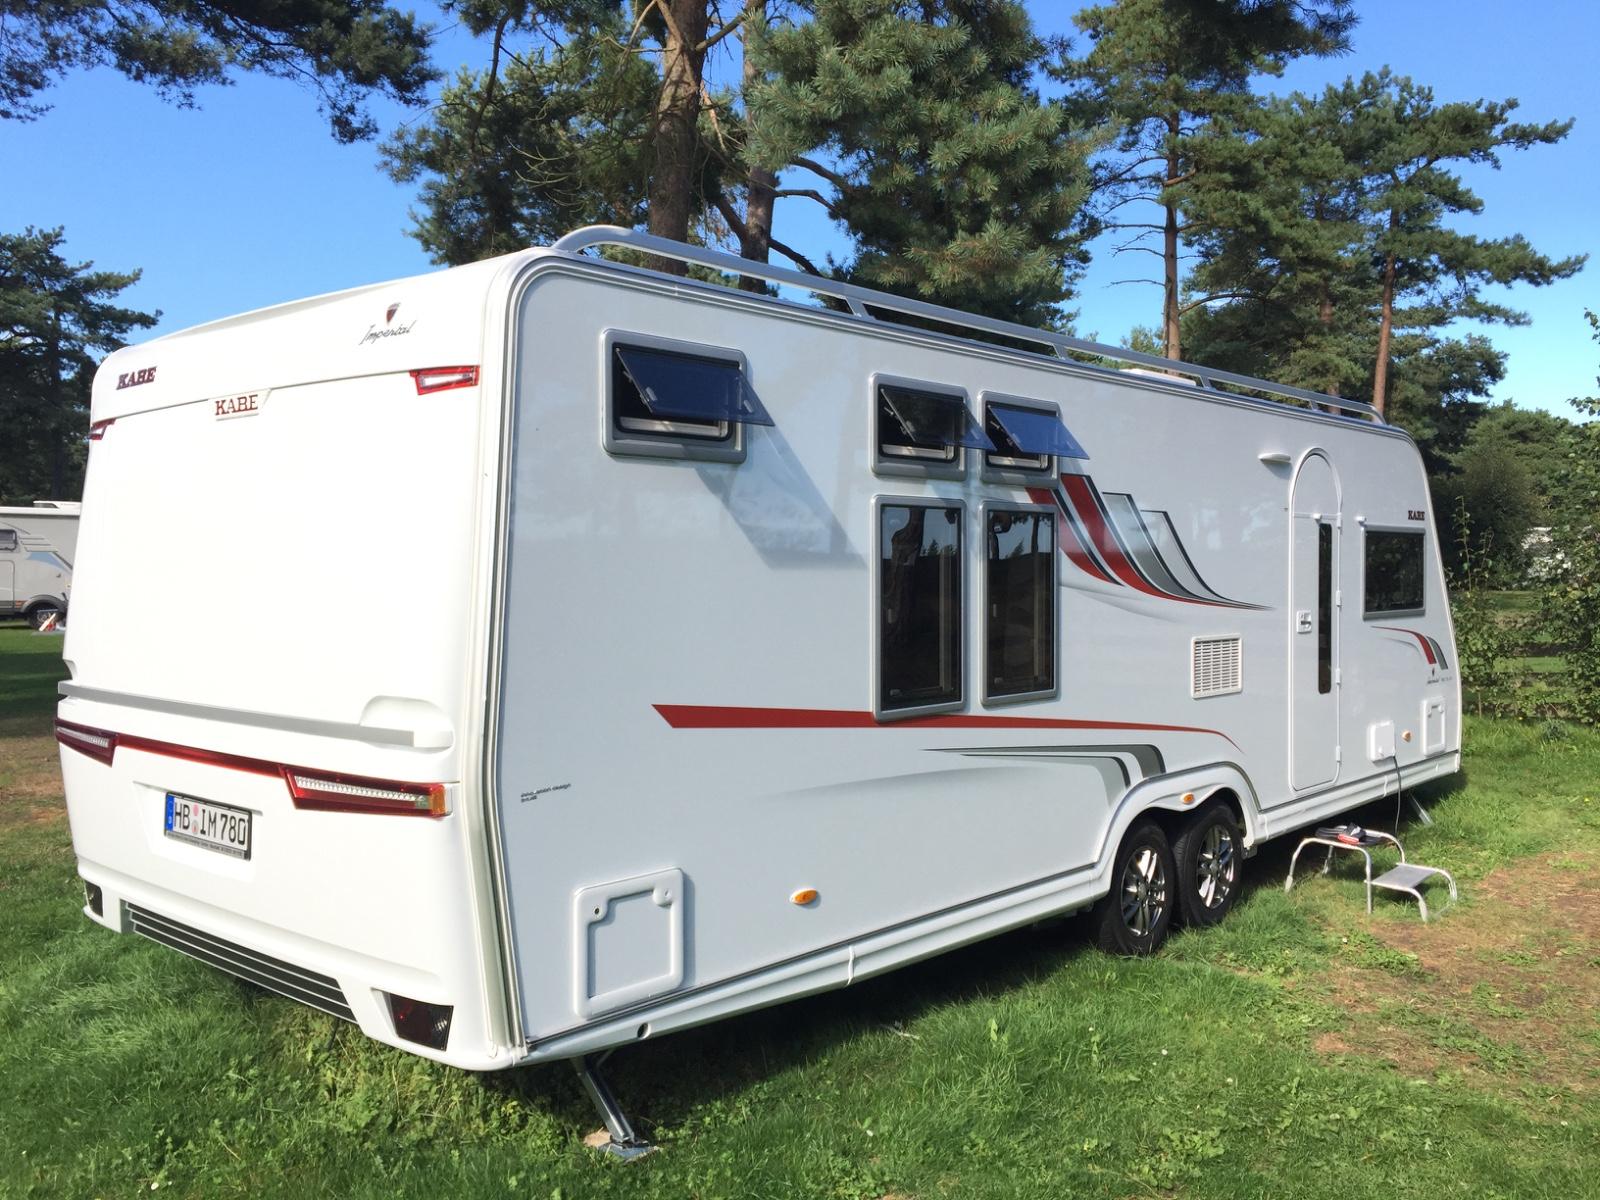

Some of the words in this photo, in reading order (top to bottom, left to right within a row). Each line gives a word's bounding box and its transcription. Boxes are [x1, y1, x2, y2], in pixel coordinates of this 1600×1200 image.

[116, 366, 157, 390] KABE
[215, 394, 258, 416] KABE
[174, 802, 191, 830] HB
[220, 813, 247, 846] 780
